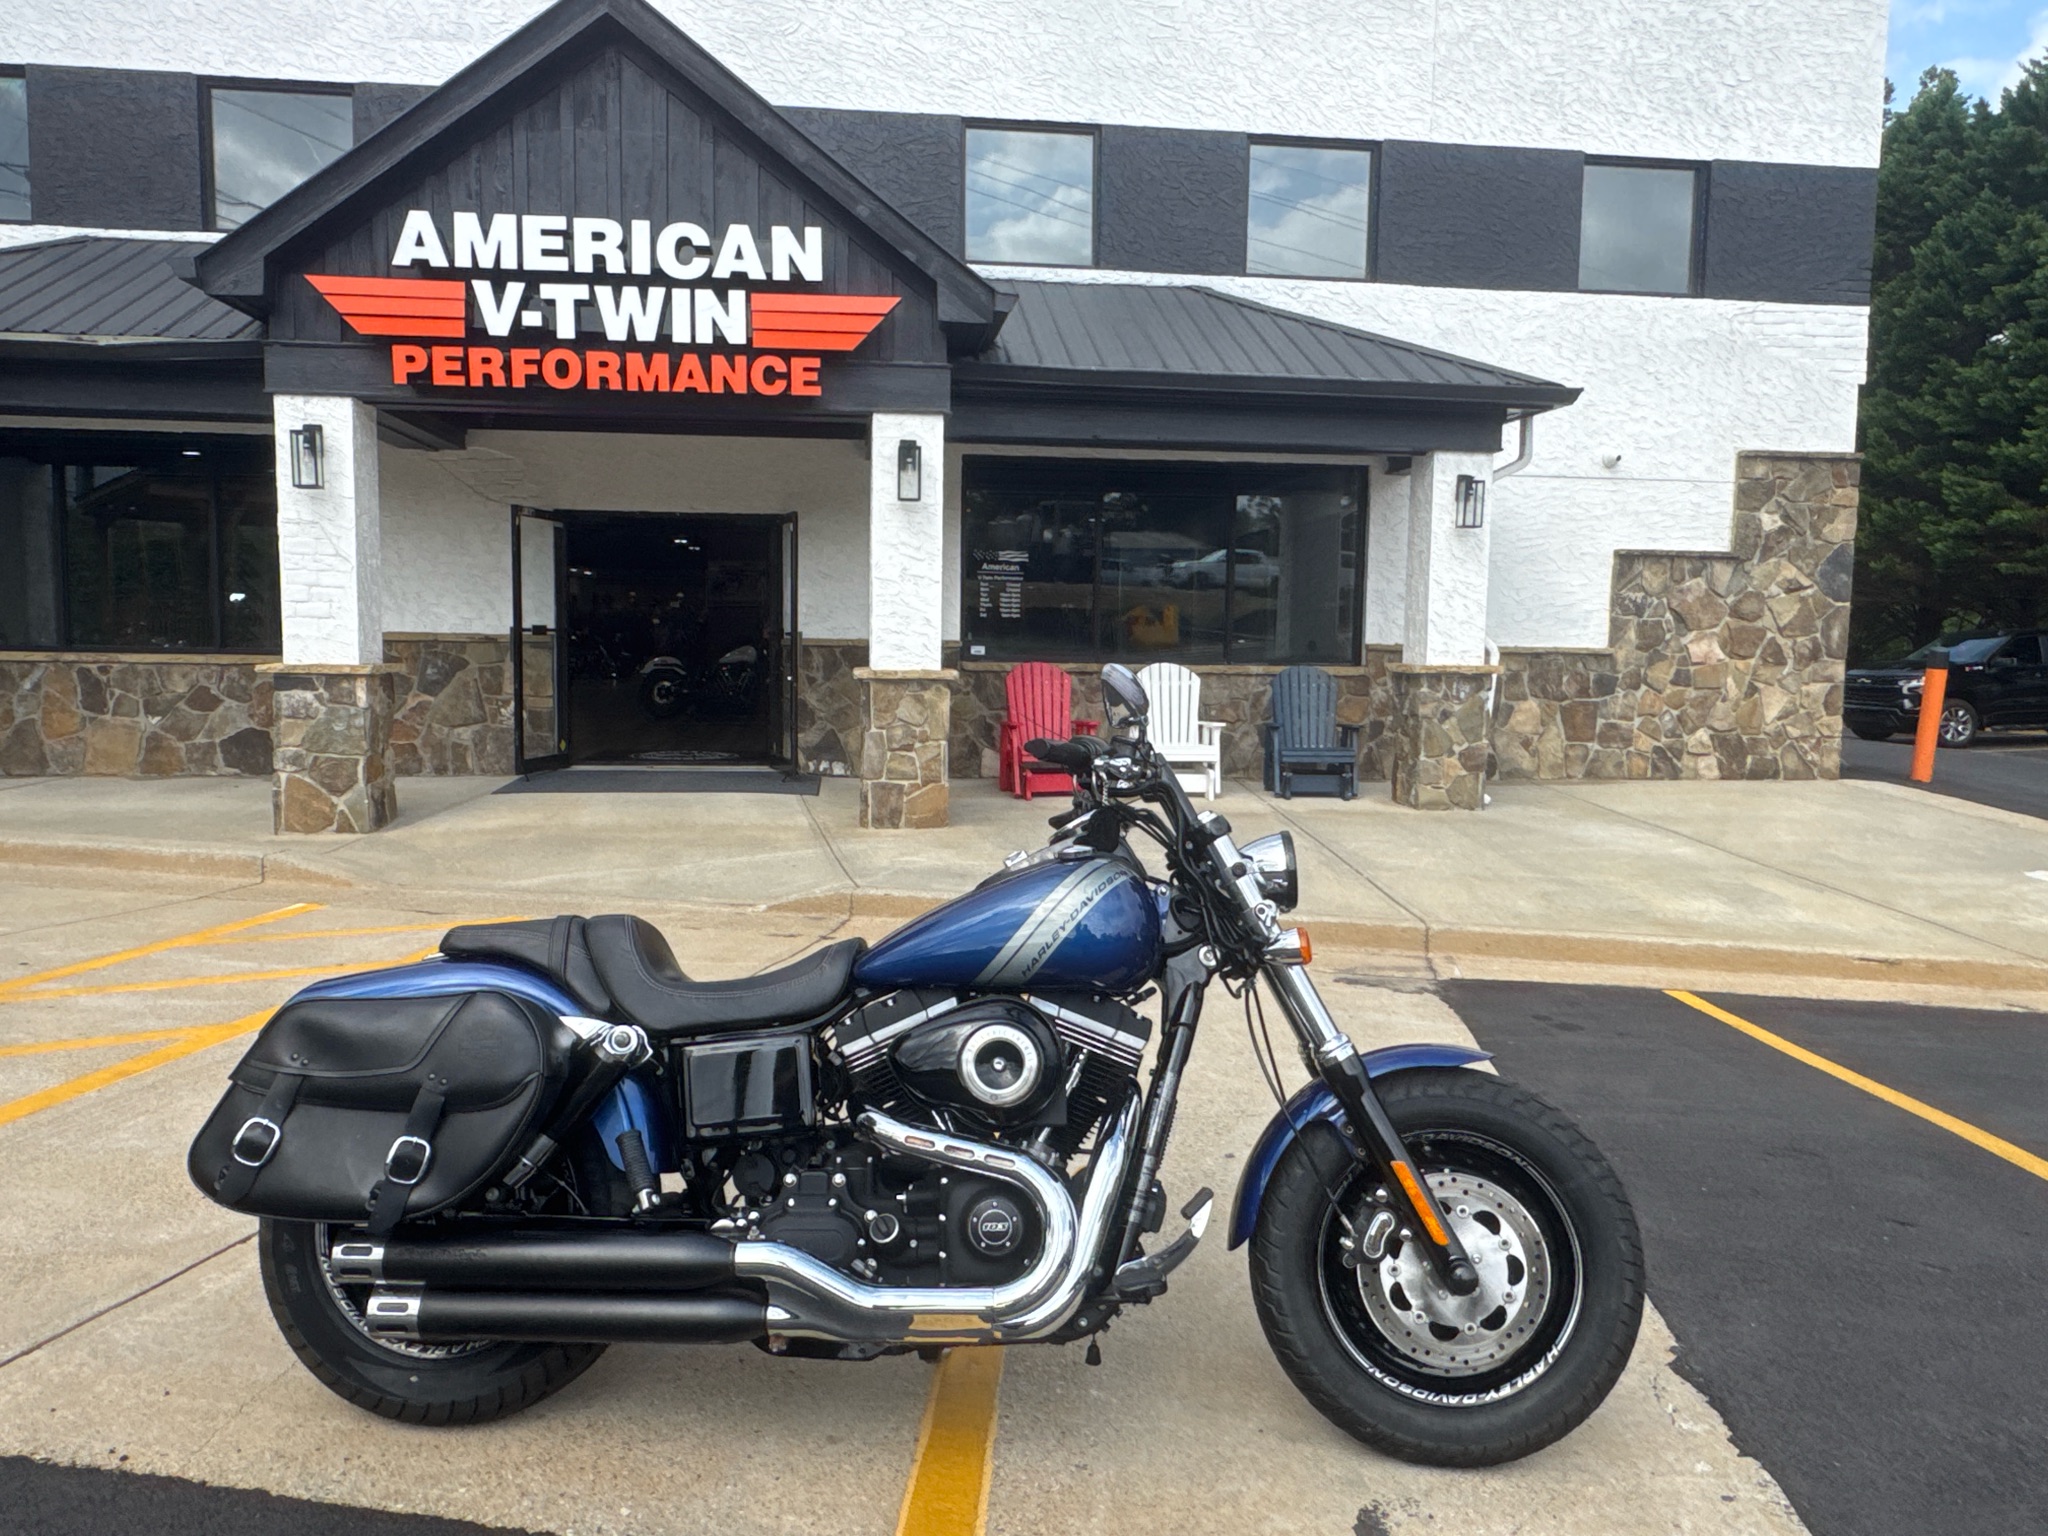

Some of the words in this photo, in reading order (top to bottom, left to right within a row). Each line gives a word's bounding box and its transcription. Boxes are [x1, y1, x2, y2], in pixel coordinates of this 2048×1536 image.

[391, 209, 823, 282] AMERICAN
[471, 279, 748, 345] V-TWIN
[391, 344, 823, 396] PERFORMANCE
[981, 562, 1020, 571] American
[1021, 869, 1128, 977] HARLEY-DAVIDSON
[1367, 1343, 1560, 1404] HARLEY-DAVIDSON
